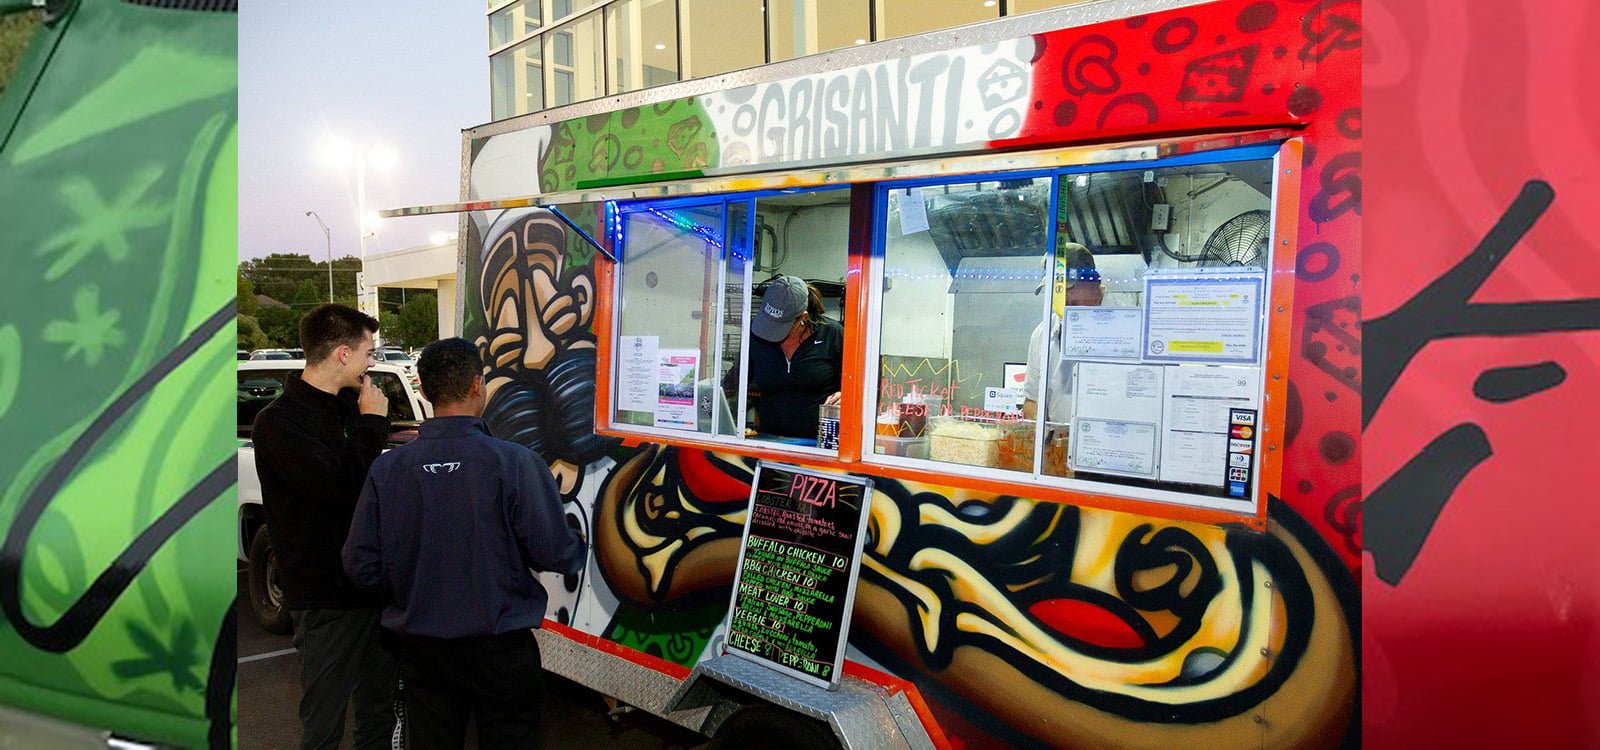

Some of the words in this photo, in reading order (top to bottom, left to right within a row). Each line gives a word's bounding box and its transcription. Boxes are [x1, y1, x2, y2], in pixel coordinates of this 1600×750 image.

[757, 55, 966, 164] GRISANTI
[881, 378, 904, 400] RED
[906, 378, 960, 401] Ticket
[878, 401, 930, 417] CHEESE
[939, 404, 954, 417] OR
[756, 494, 791, 509] LOBSTER
[789, 473, 836, 509] PIZZA
[747, 535, 785, 555] BUFFALO
[787, 546, 826, 564] CHICKEN
[832, 556, 845, 568] 10
[743, 558, 761, 572] BBQ
[762, 565, 801, 584] CHICKEN
[802, 577, 814, 587] 10
[739, 583, 764, 599] MEAT
[765, 591, 790, 607] LOVER
[794, 600, 804, 611] 10
[735, 607, 767, 626] VEGGIE
[772, 620, 781, 630] 10
[795, 611, 833, 630] PEPPERONI
[728, 631, 762, 653] CHEESE
[764, 643, 772, 656] 8
[778, 649, 819, 674] PEPPERONI
[821, 665, 831, 677] 8
